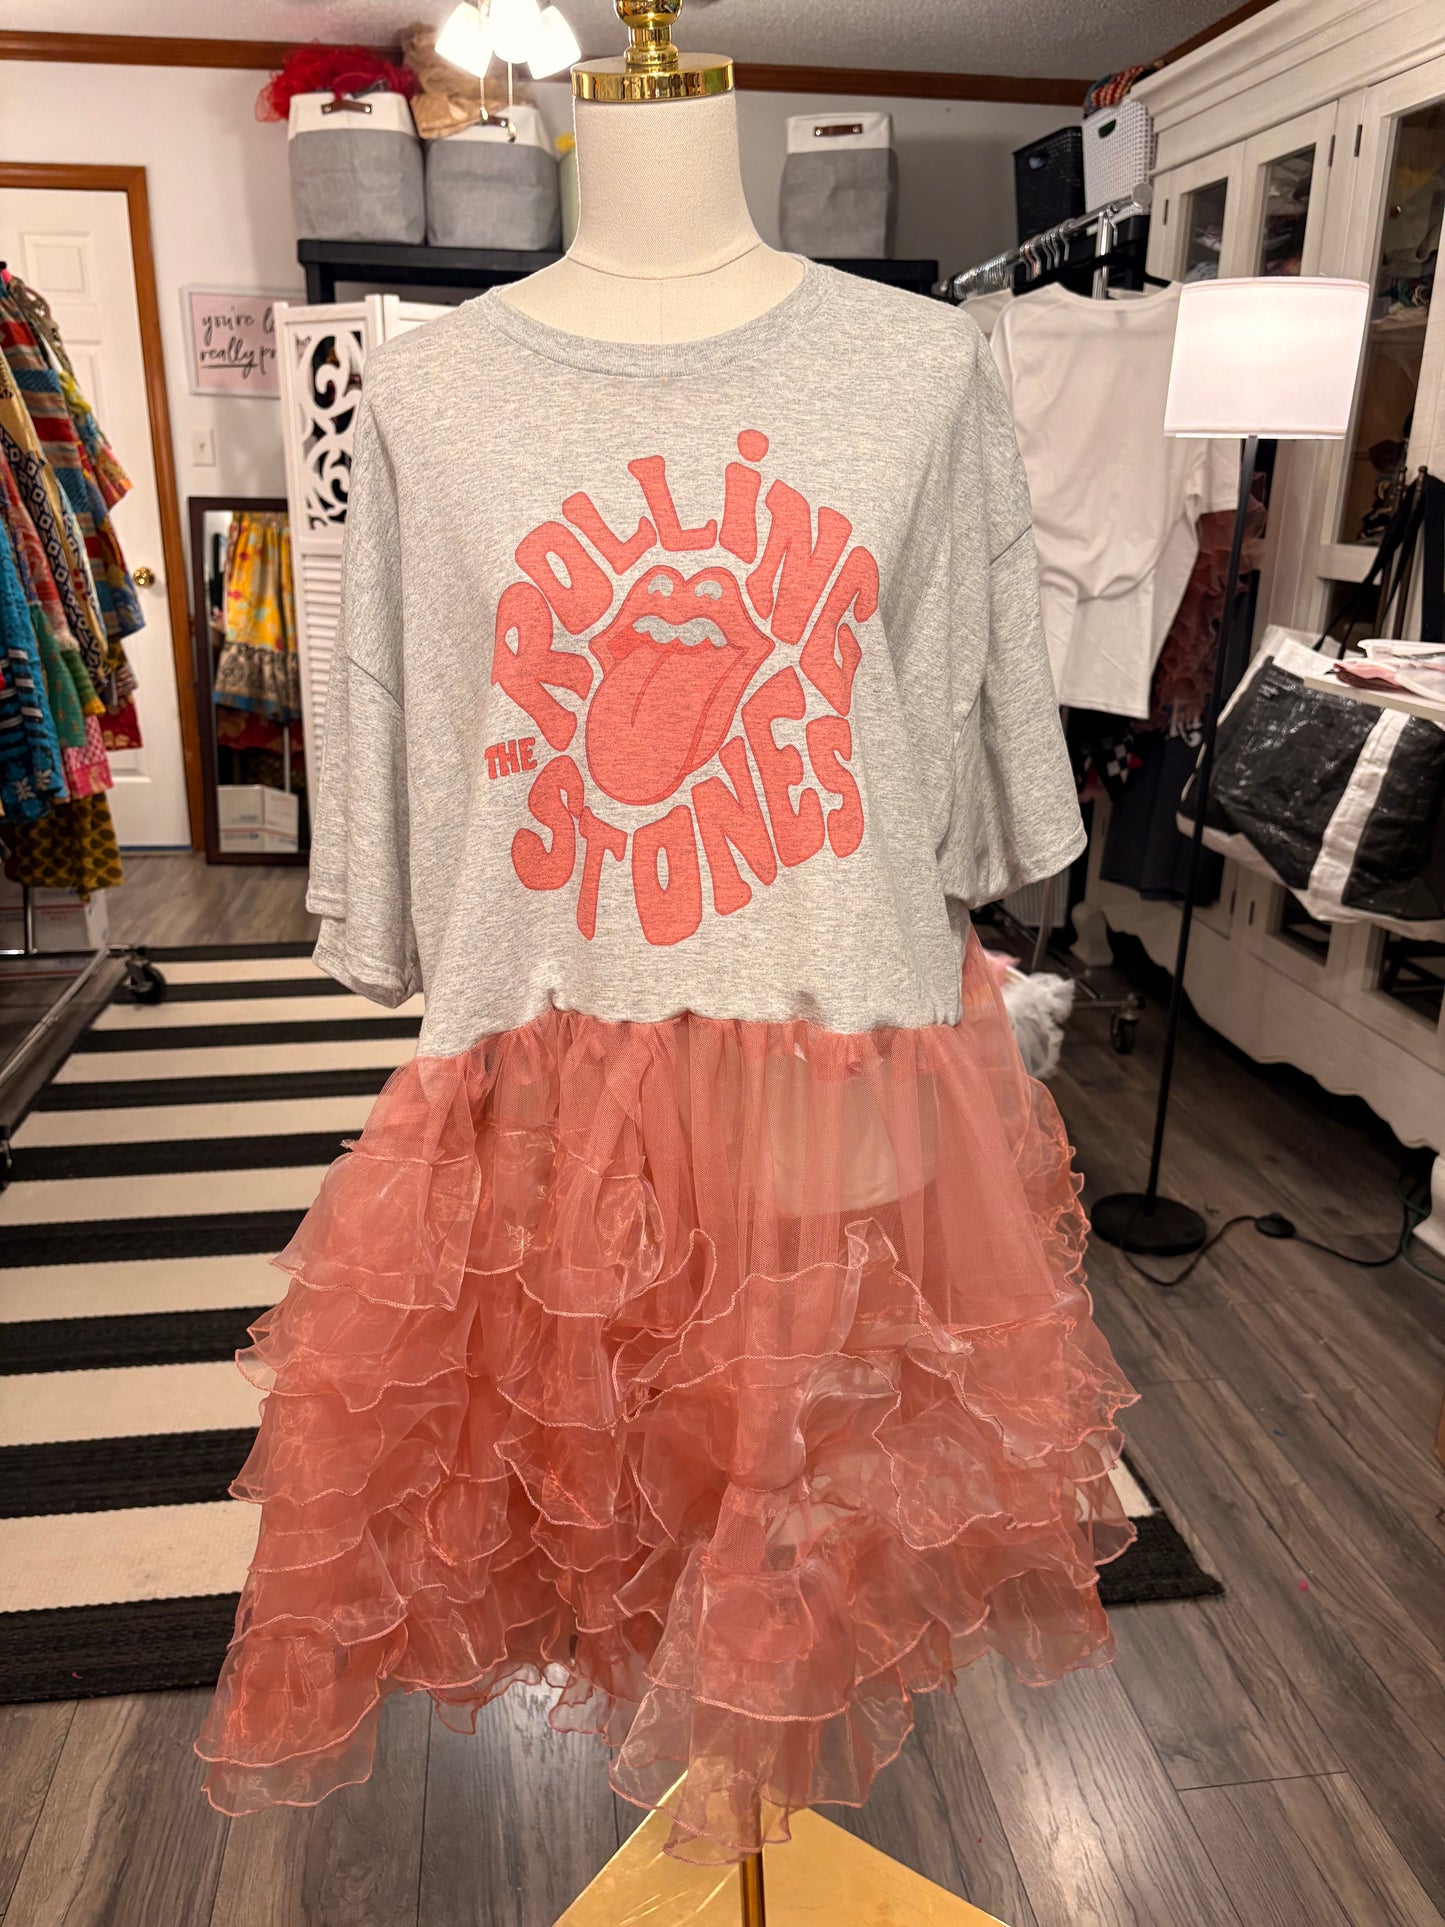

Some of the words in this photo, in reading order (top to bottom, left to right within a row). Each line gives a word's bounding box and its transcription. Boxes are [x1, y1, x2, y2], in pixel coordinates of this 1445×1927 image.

[202, 305, 255, 347] you're
[200, 336, 258, 380] really
[484, 737, 538, 780] THE
[511, 666, 864, 946] STONES
